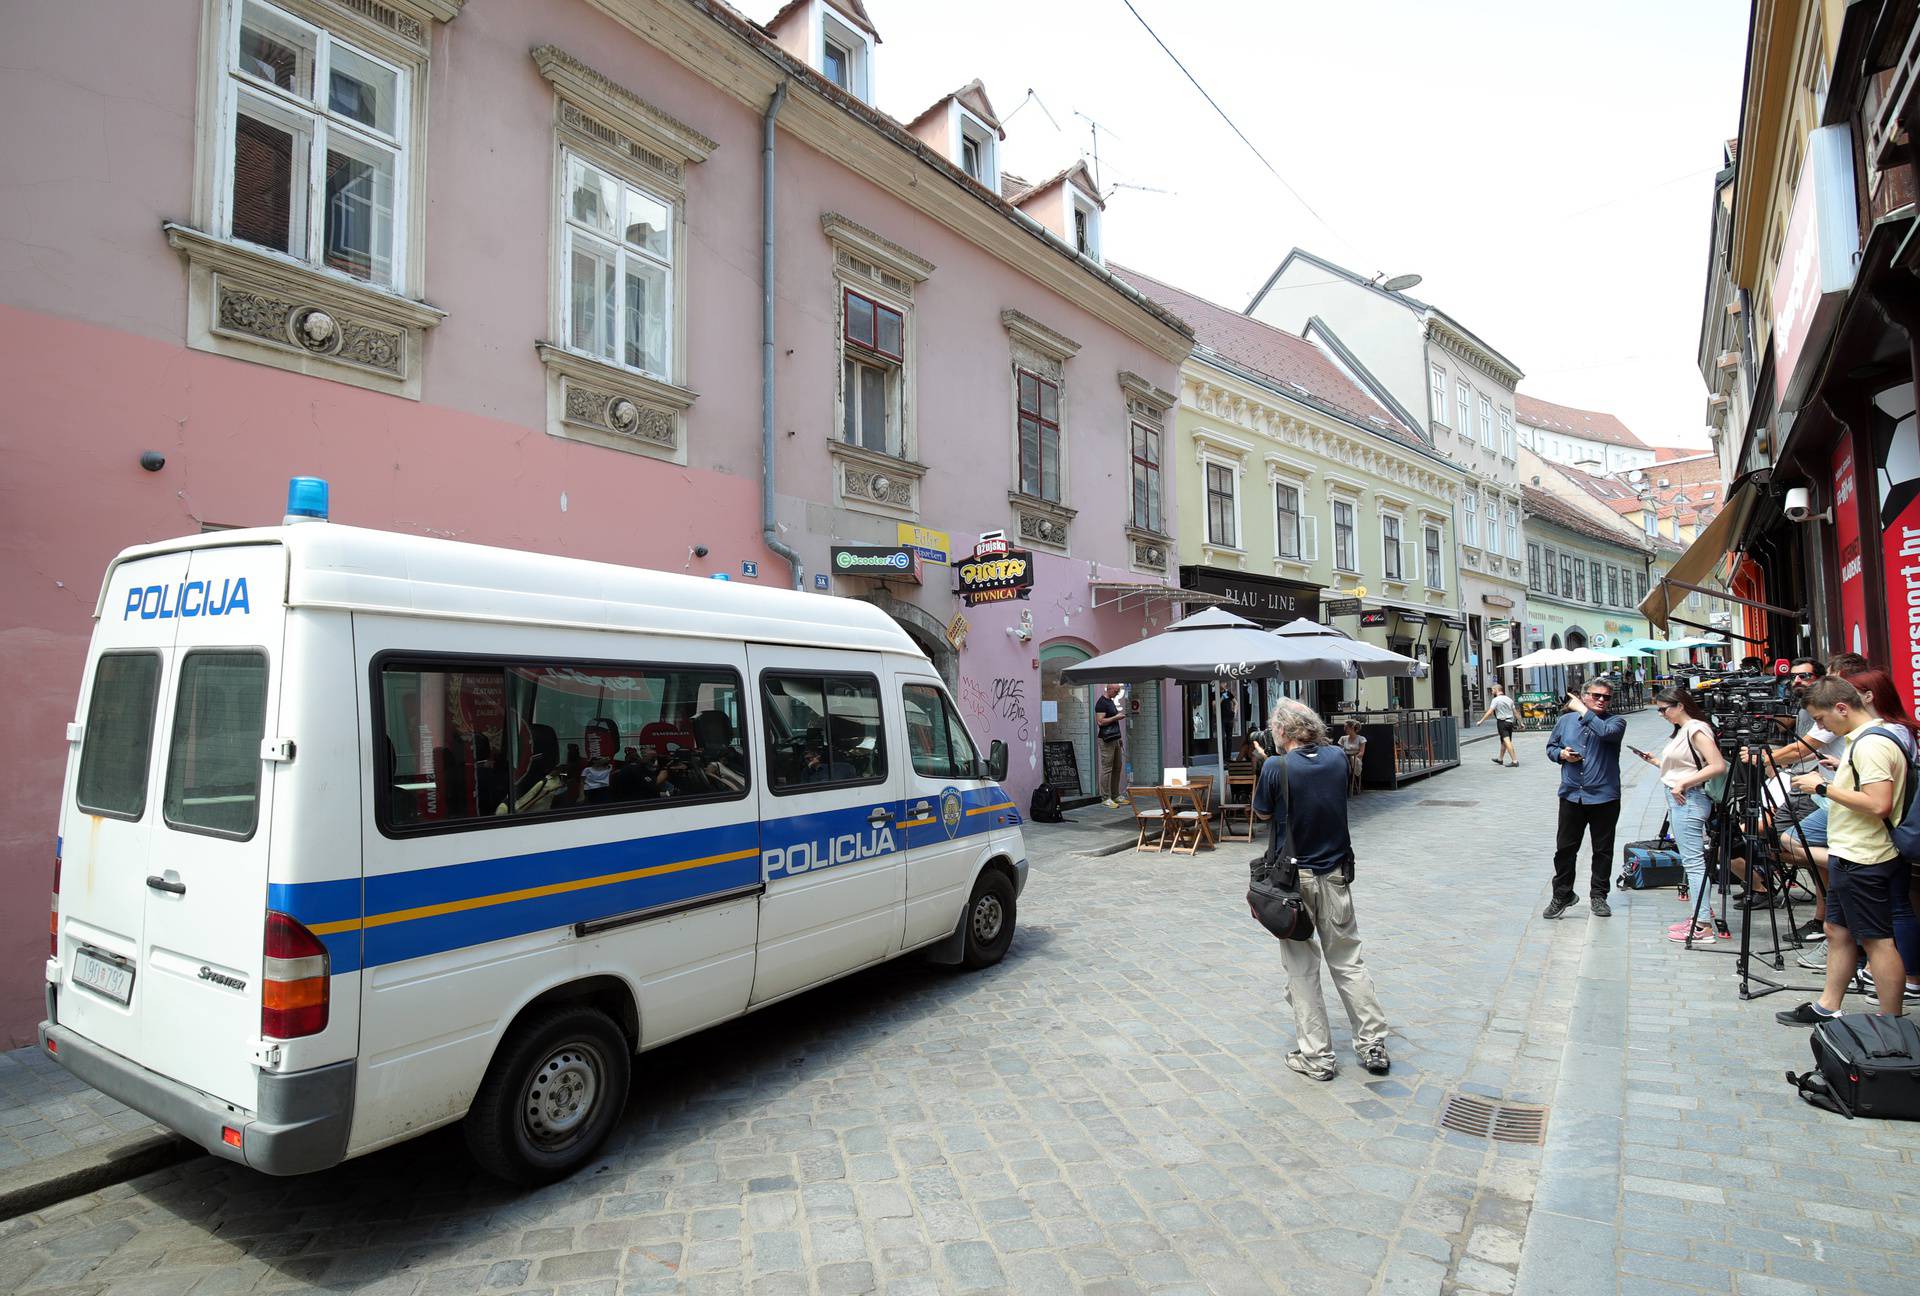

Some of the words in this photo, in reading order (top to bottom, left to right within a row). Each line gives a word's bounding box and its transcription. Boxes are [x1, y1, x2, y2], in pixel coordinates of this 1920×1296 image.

[977, 540, 1006, 555] Ožujsko
[747, 565, 753, 573] 3
[961, 558, 1026, 584] PINTA
[971, 579, 1015, 588] ZAGREB
[124, 577, 250, 621] POLICIJA
[970, 588, 1017, 603] (PIVNICA)
[1268, 594, 1295, 611] LINE
[1215, 661, 1256, 679] Melt
[762, 827, 896, 881] POLICIJA
